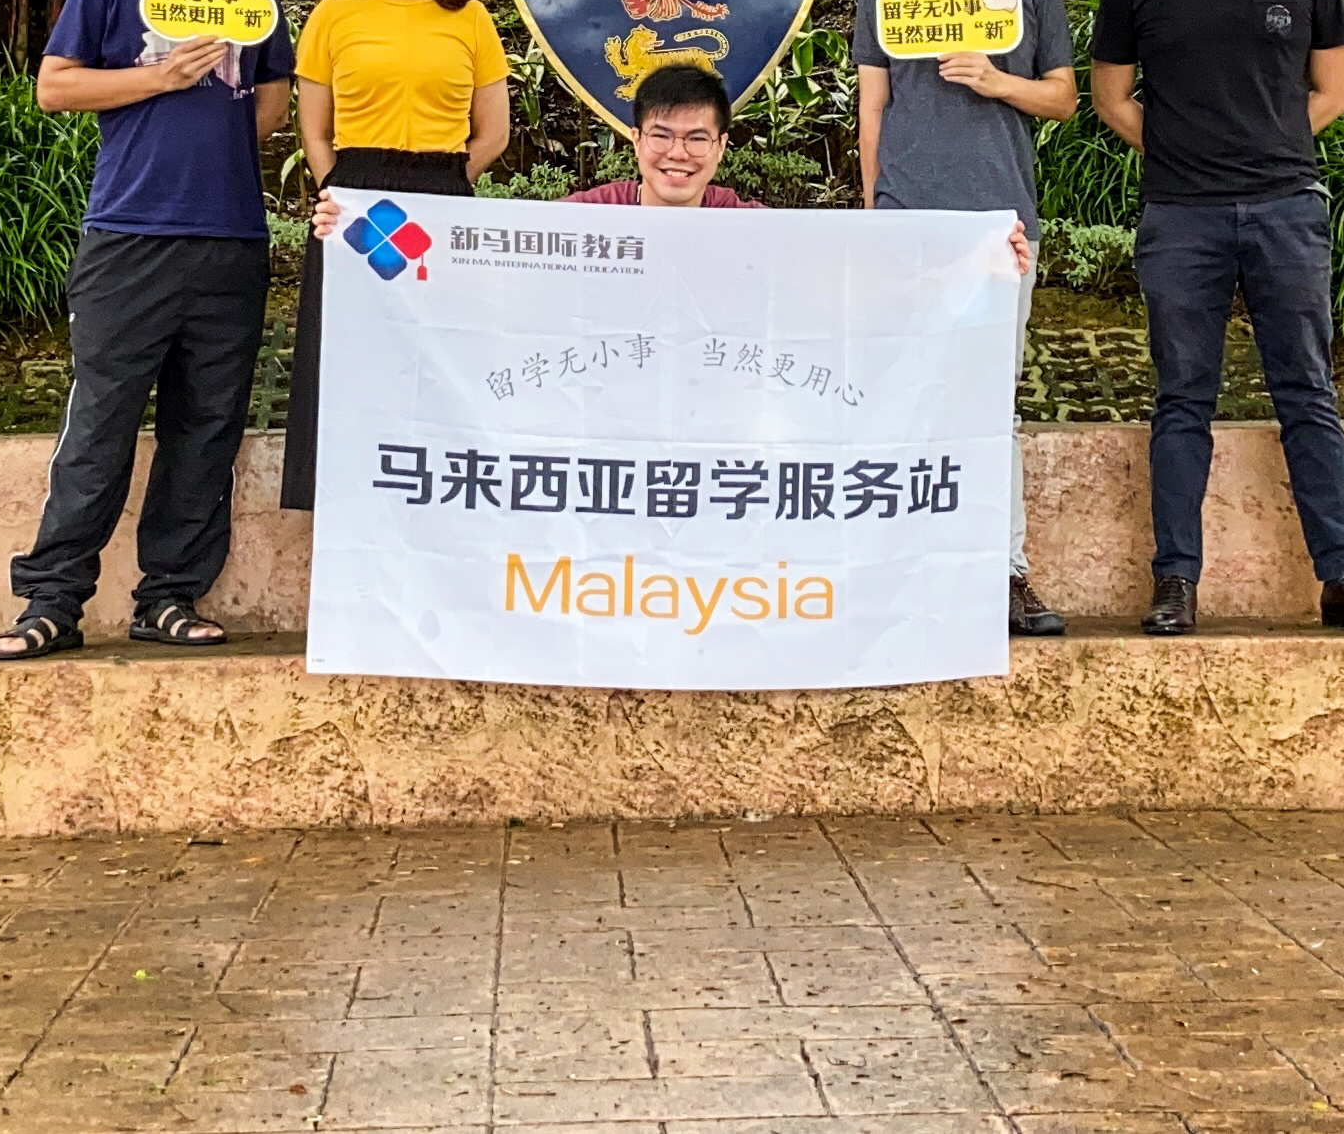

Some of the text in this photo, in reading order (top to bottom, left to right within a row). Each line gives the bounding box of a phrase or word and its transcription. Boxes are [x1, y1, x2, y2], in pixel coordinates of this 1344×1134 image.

[450, 225, 645, 261] 新马国际教育
[451, 256, 470, 265] XIN
[472, 258, 492, 266] MA
[485, 333, 866, 408] 留学无小事 当然更用心
[372, 442, 961, 521] 马来西亚留学服务站
[503, 553, 836, 636] Malaysia
